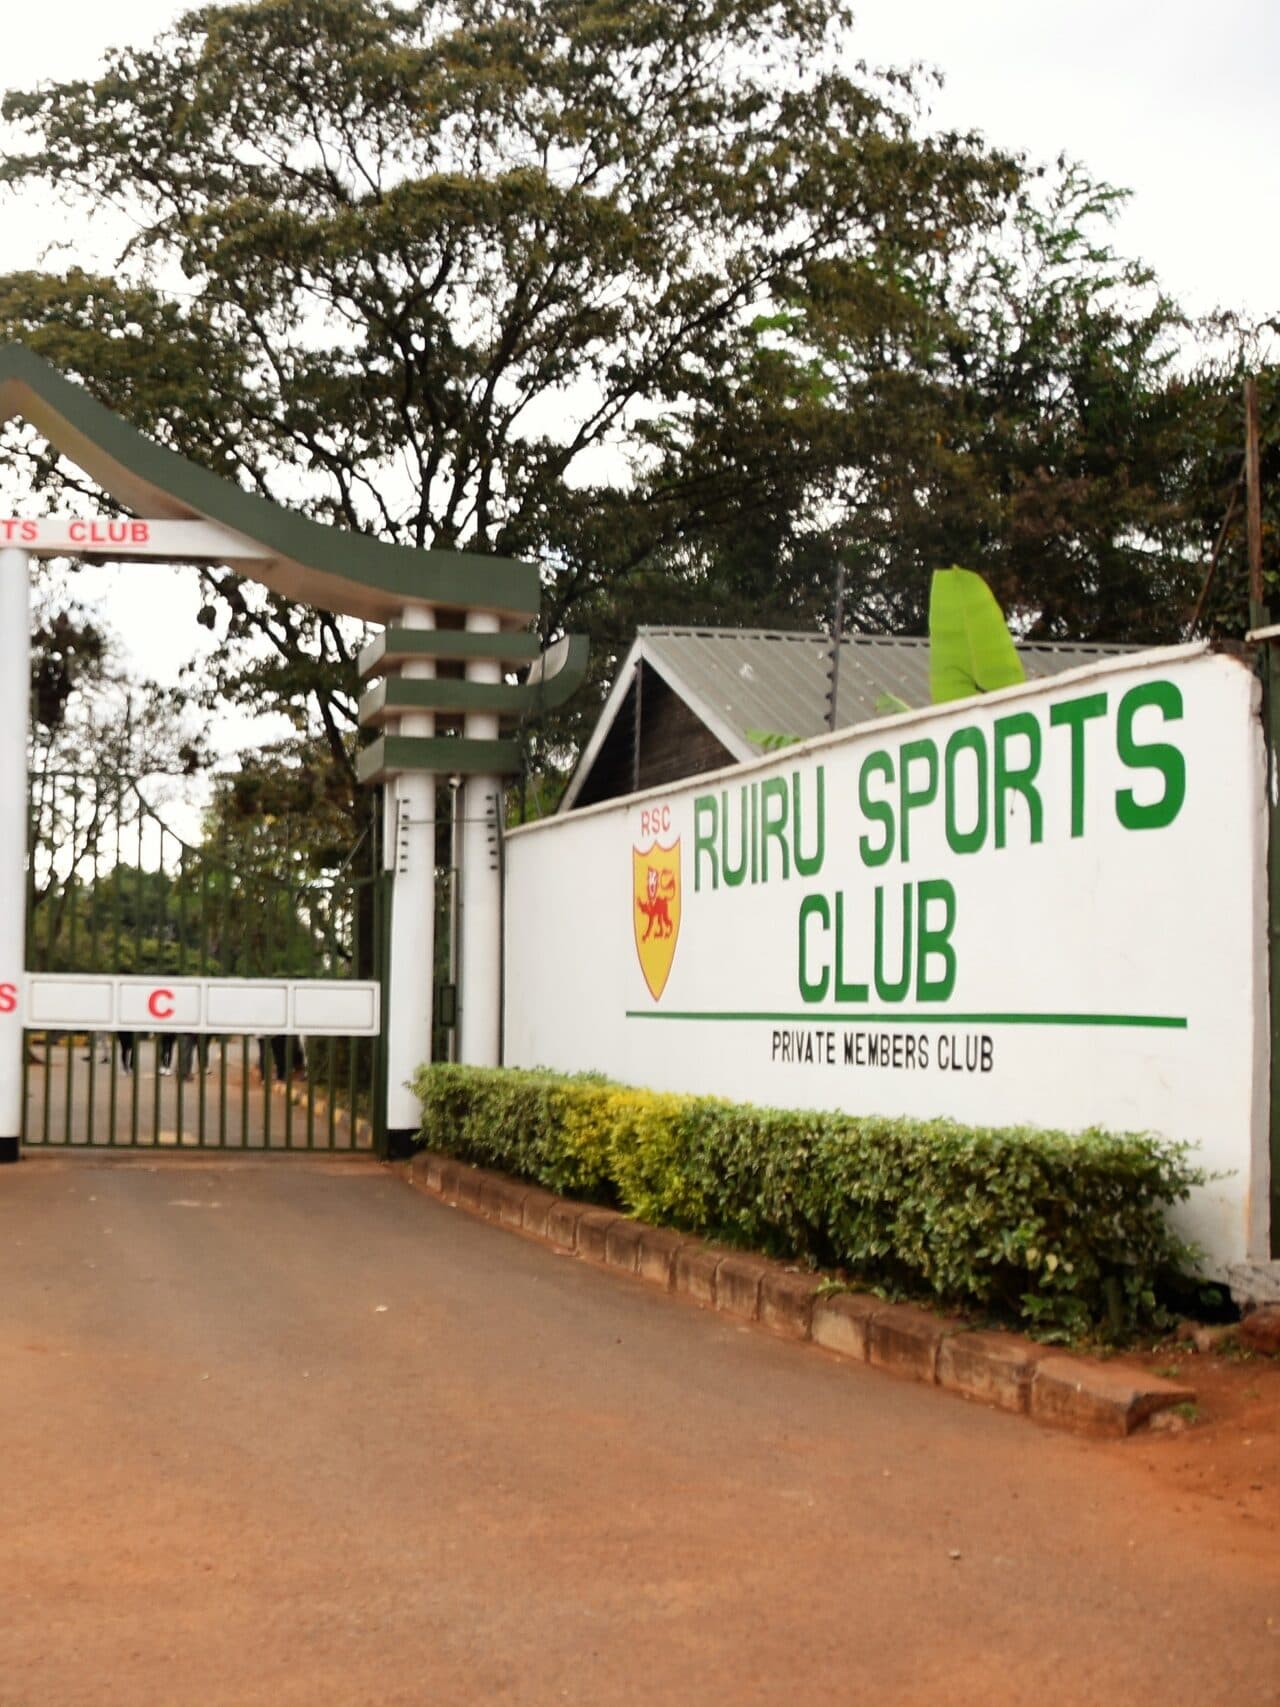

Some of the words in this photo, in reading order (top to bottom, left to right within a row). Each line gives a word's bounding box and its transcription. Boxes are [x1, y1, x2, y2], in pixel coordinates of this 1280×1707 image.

[69, 521, 150, 546] CLUB
[693, 766, 825, 892] RUIRU
[859, 680, 1187, 867] SPORTS
[640, 804, 671, 836] RSC
[799, 879, 958, 1003] CLUB
[147, 989, 176, 1019] C
[771, 1030, 837, 1065] PRIVATE
[844, 1032, 931, 1070] MEMBERS
[937, 1035, 995, 1073] CLUB
